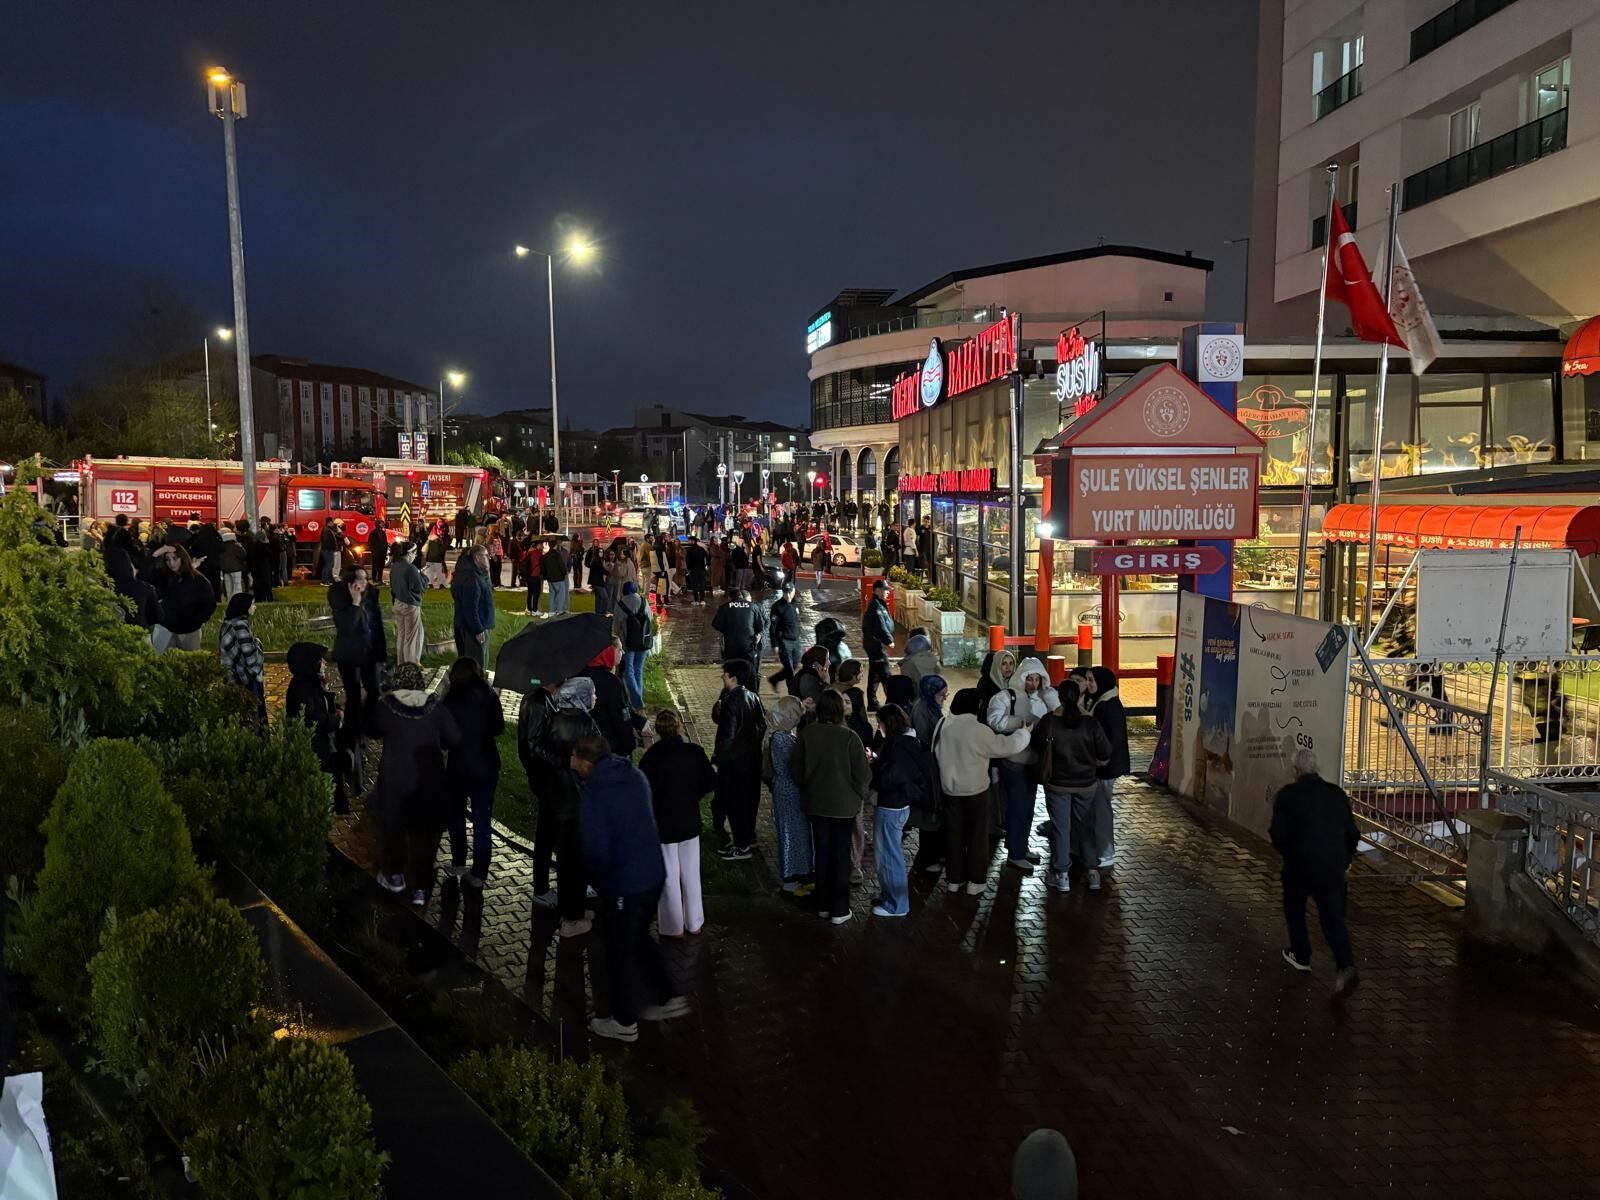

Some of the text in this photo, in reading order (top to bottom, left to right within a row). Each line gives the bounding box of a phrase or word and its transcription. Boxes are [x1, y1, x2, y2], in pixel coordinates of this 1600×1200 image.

[1254, 423, 1281, 436] Talas
[168, 475, 203, 484] KAYSERİ
[1080, 463, 1249, 498] ŞULE YÜKSEL ŞENLER
[114, 491, 135, 504] 112
[159, 493, 212, 501] BÜYÜKŞEHİR
[1092, 502, 1236, 533] YURT MÜDÜRLÜĞÜ
[1296, 732, 1314, 750] GSB
